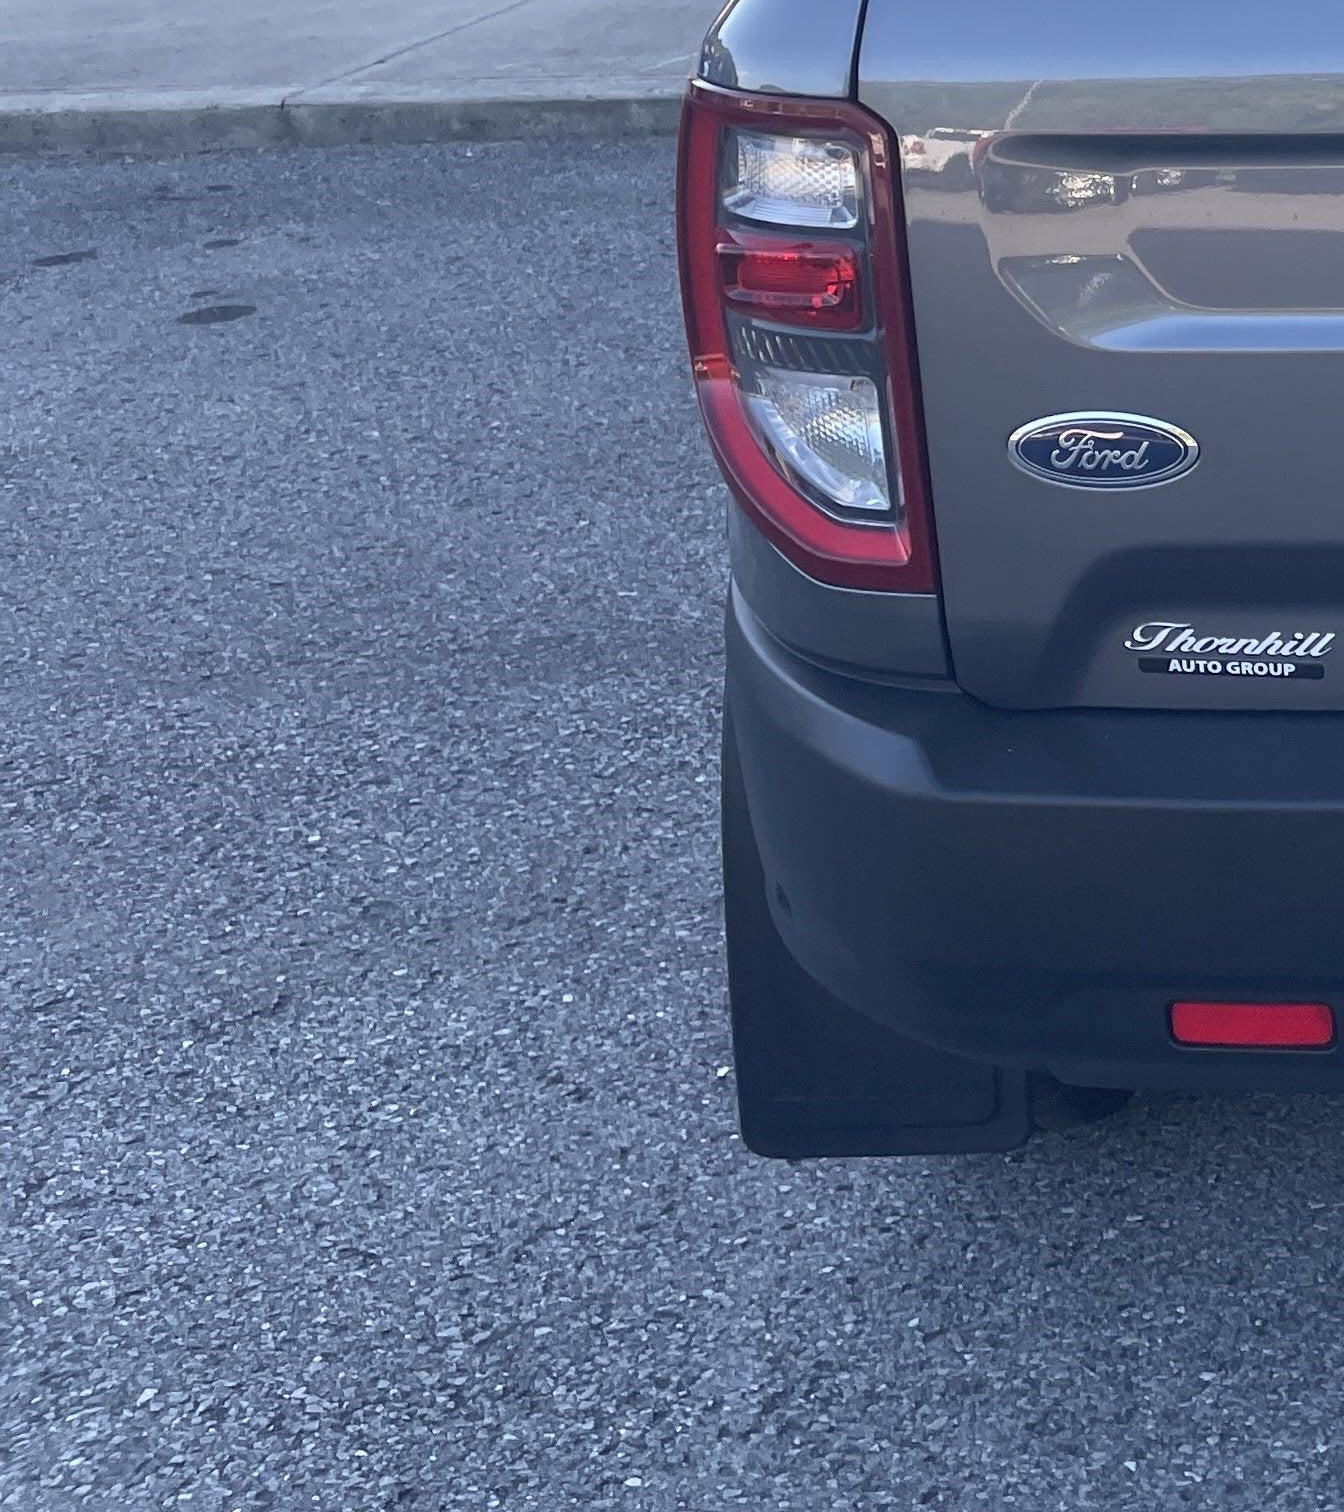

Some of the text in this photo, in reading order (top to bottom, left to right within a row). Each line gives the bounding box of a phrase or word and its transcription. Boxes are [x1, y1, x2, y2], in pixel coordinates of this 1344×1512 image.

[1050, 429, 1150, 471] Ford
[1124, 621, 1336, 658] Thornhill
[1168, 658, 1296, 677] AUTO GROUP
